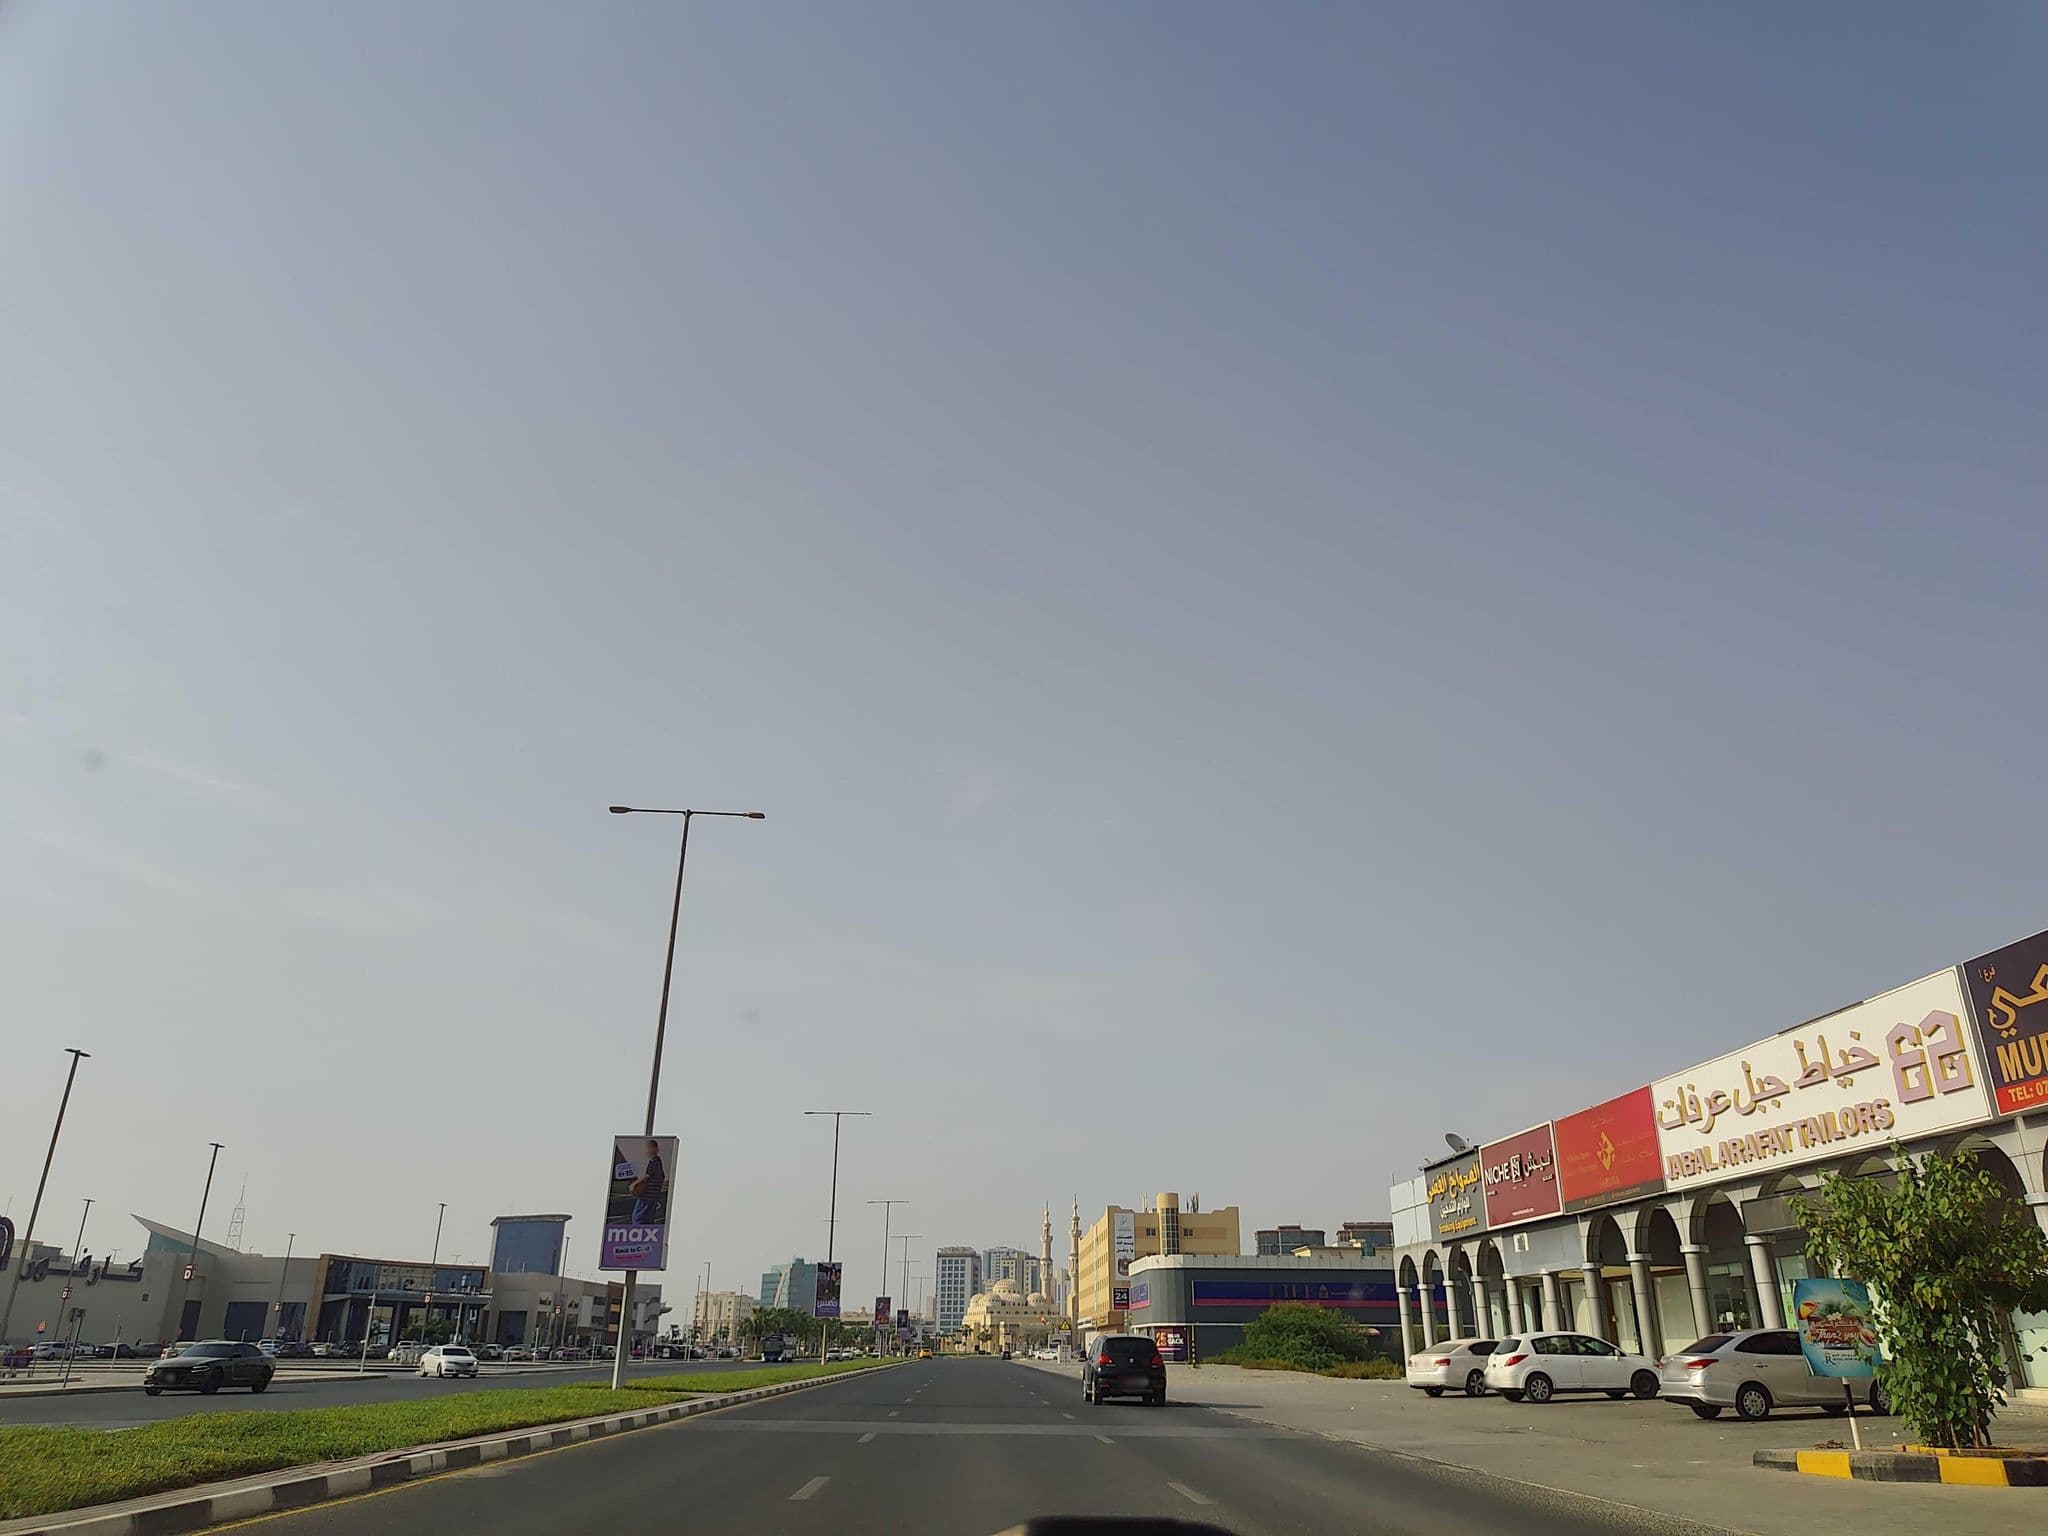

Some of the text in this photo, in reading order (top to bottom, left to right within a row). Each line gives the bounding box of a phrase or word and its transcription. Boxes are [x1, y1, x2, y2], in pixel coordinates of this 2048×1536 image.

[1657, 1031, 1880, 1134] خياط جبل عرفات
[2008, 1084, 2035, 1103] TEL:
[1666, 1145, 1719, 1181] JABAL
[1719, 1123, 1794, 1169] ARAFAT
[1792, 1098, 1895, 1148] TAILORS
[1485, 1162, 1511, 1186] NICHE
[607, 1228, 659, 1242] max
[1115, 1293, 1128, 1301] 24
